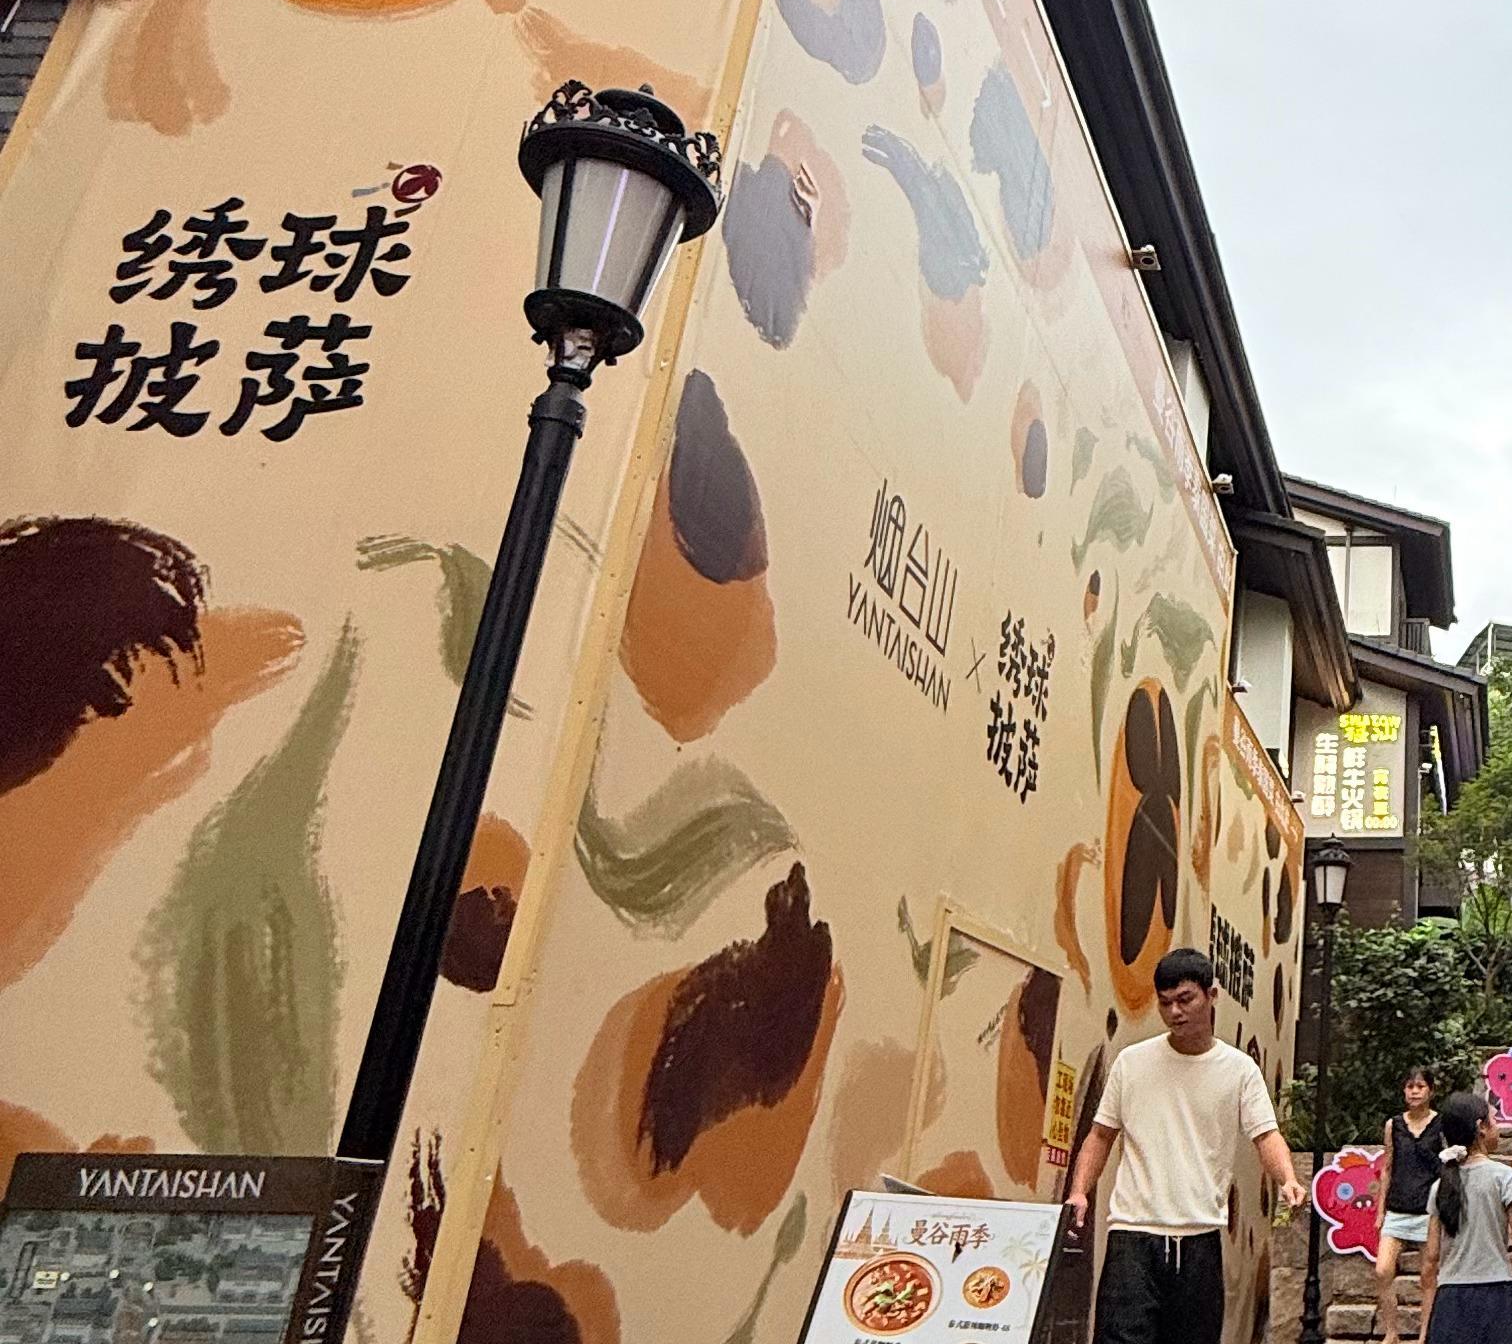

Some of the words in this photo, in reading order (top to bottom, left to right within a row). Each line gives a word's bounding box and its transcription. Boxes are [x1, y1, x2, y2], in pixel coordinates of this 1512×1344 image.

[108, 196, 413, 311] 绣球
[64, 312, 373, 443] 披萨
[863, 477, 958, 658] 烟台山
[847, 571, 952, 715] YANTAISHAN
[997, 608, 1049, 722] 绣球
[986, 689, 1041, 805] 披萨
[78, 1167, 266, 1199] YANTAISHAN
[908, 1218, 992, 1250] 曼谷雨季
